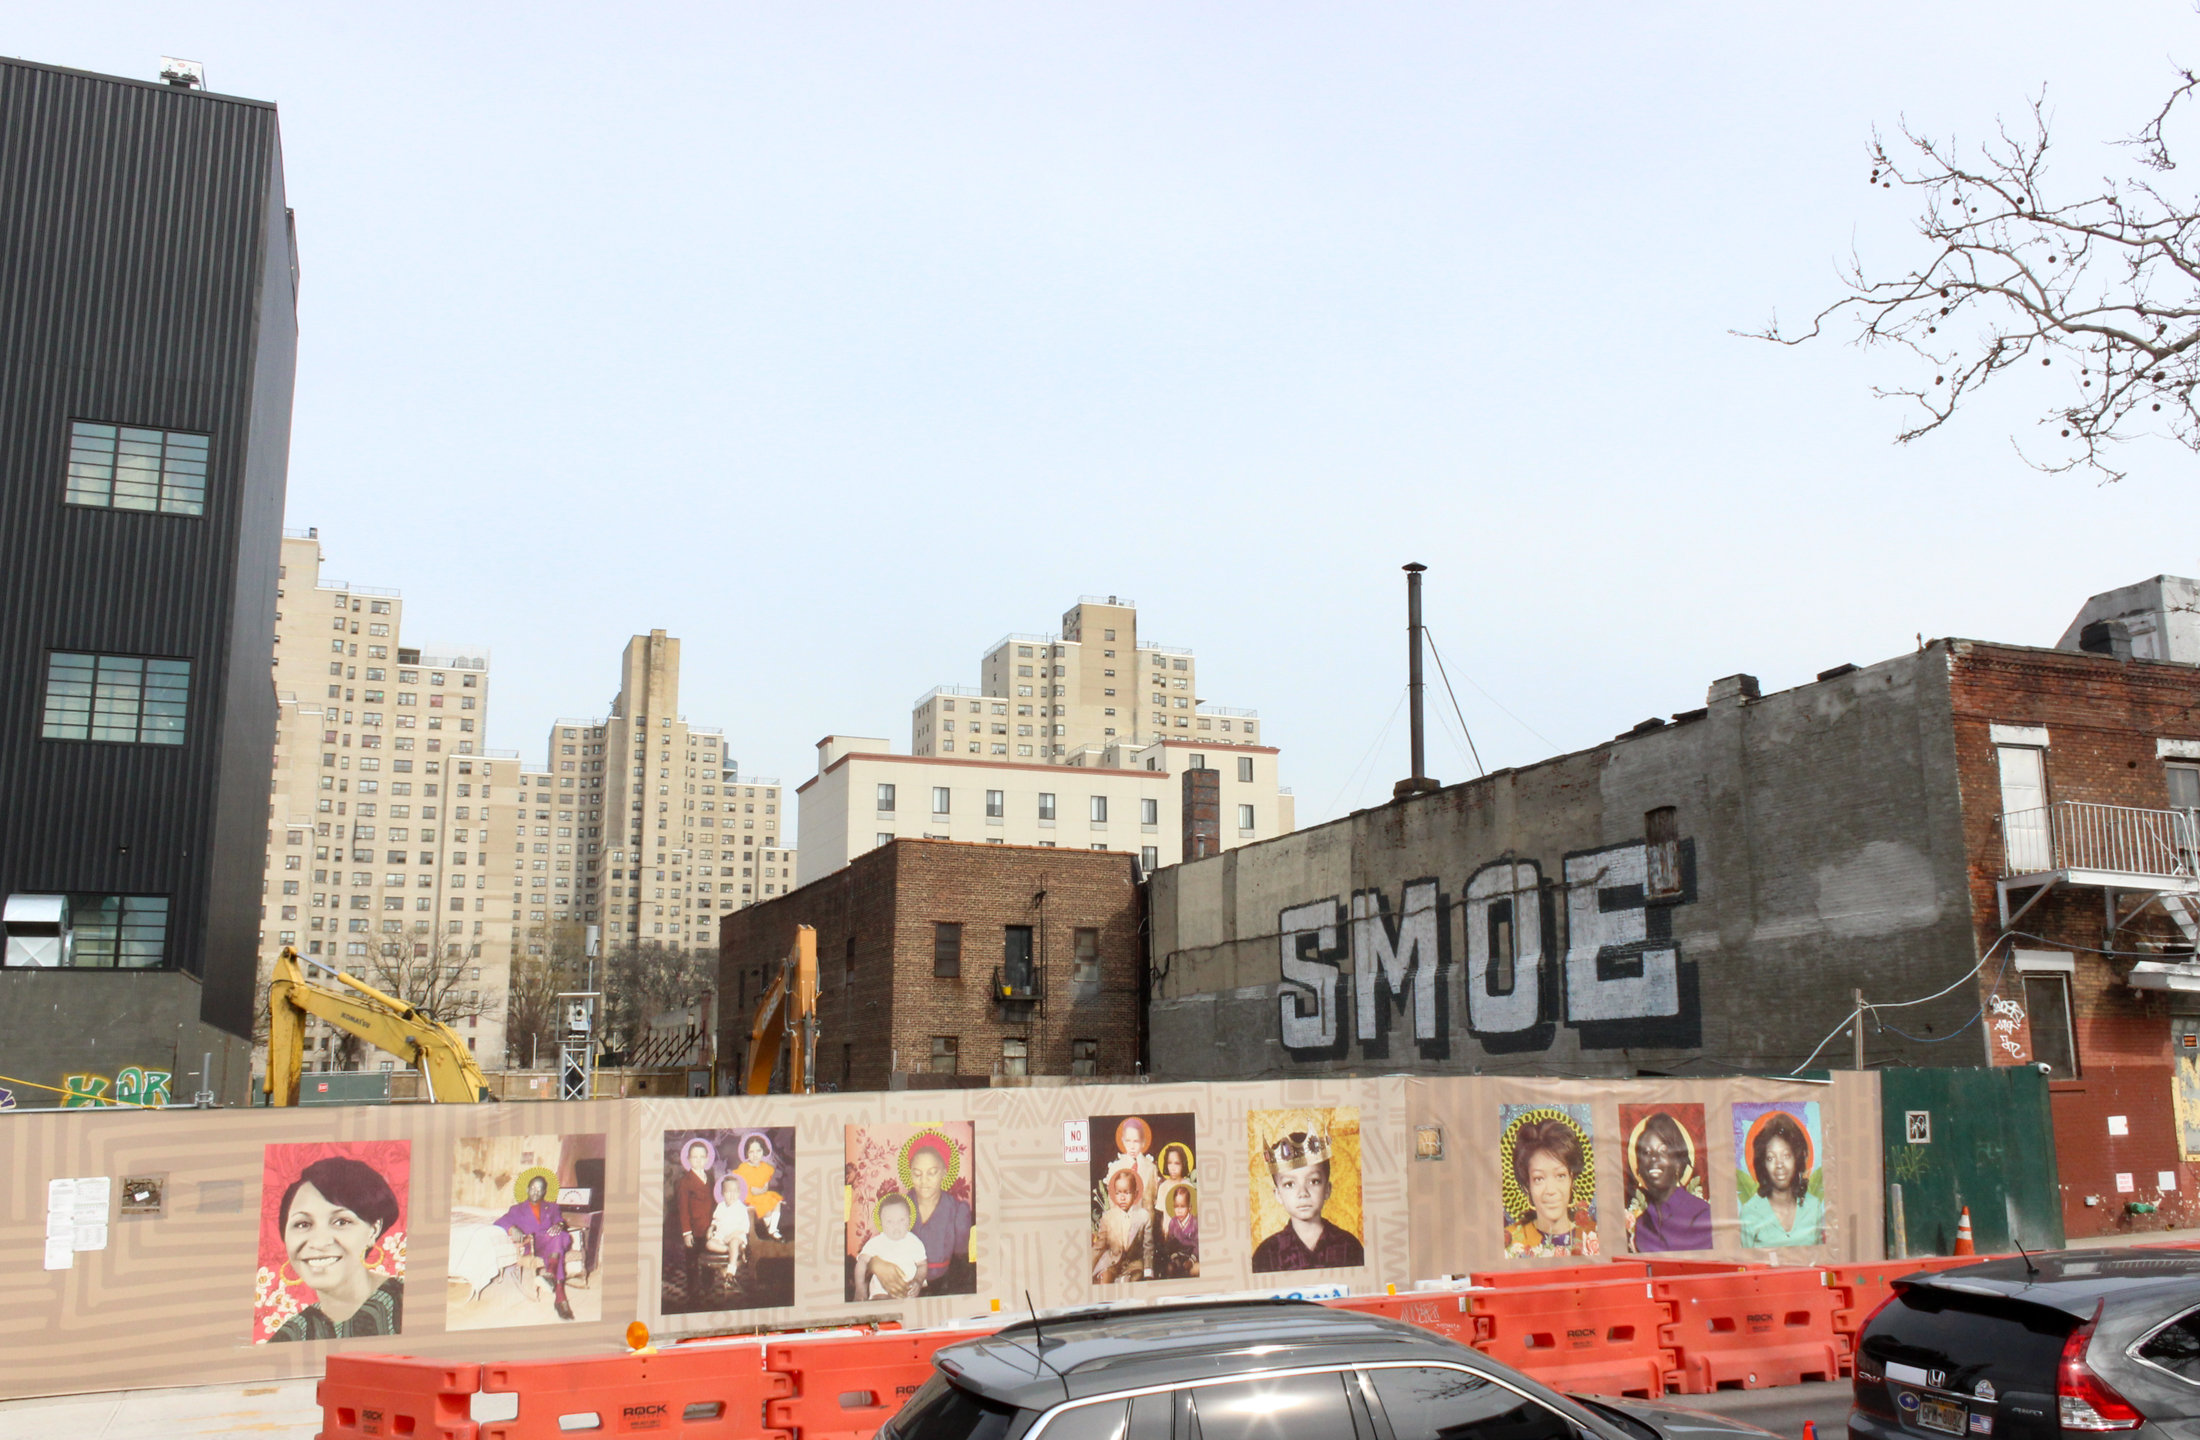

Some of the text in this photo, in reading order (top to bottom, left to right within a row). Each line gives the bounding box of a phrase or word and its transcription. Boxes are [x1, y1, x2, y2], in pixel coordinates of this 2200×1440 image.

[341, 1012, 371, 1028] KOMATSU
[1070, 1130, 1081, 1141] NO
[1065, 1145, 1088, 1153] PARKING
[1746, 1313, 1774, 1323] ROCK
[1567, 1328, 1596, 1338] ROCK
[362, 1409, 384, 1421] ROCK
[623, 1404, 667, 1417] ROCK
